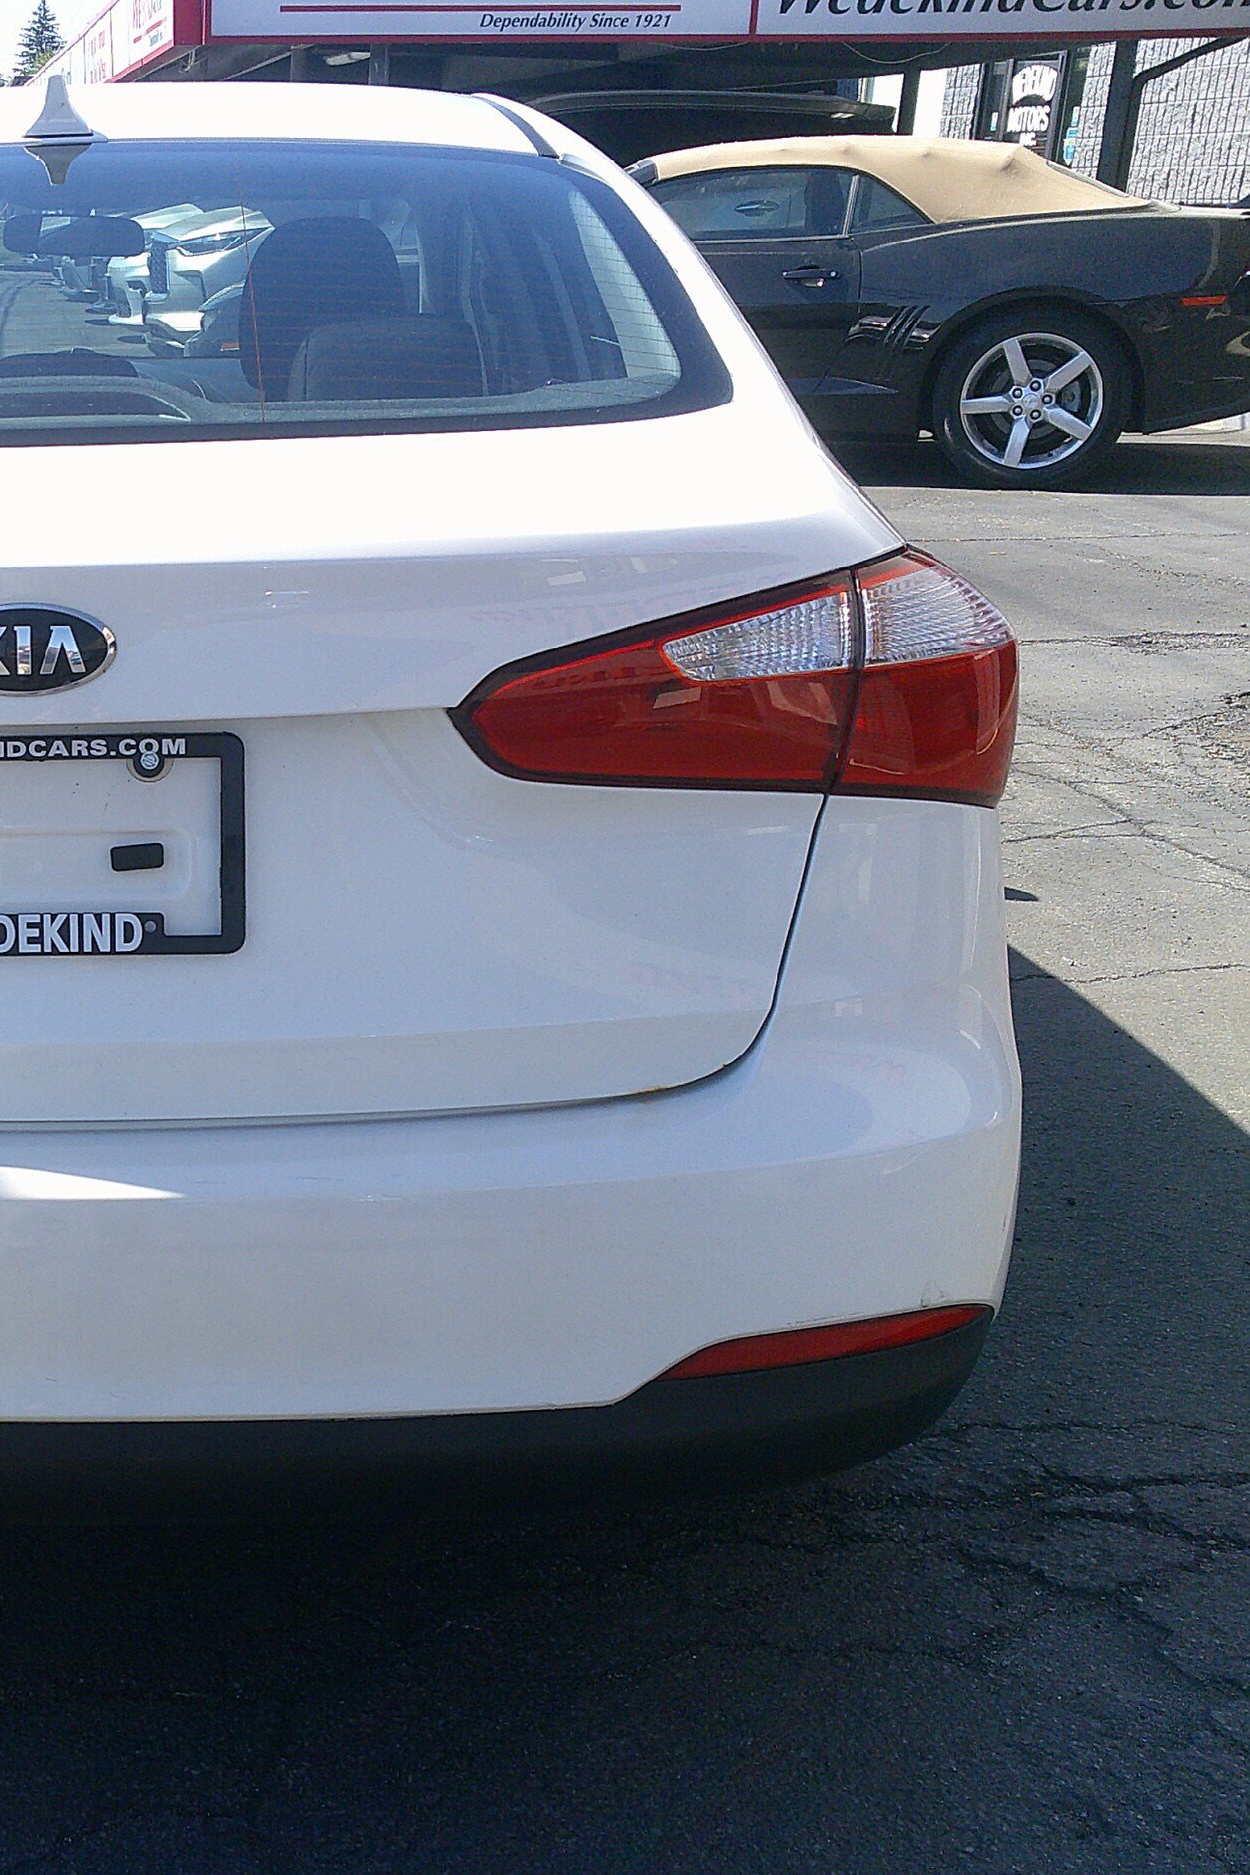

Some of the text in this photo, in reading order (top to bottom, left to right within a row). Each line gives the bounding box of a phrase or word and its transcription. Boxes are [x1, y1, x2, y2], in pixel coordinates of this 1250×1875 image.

[480, 13, 671, 31] Dependability Since 1921
[1007, 105, 1051, 132] MOTORS
